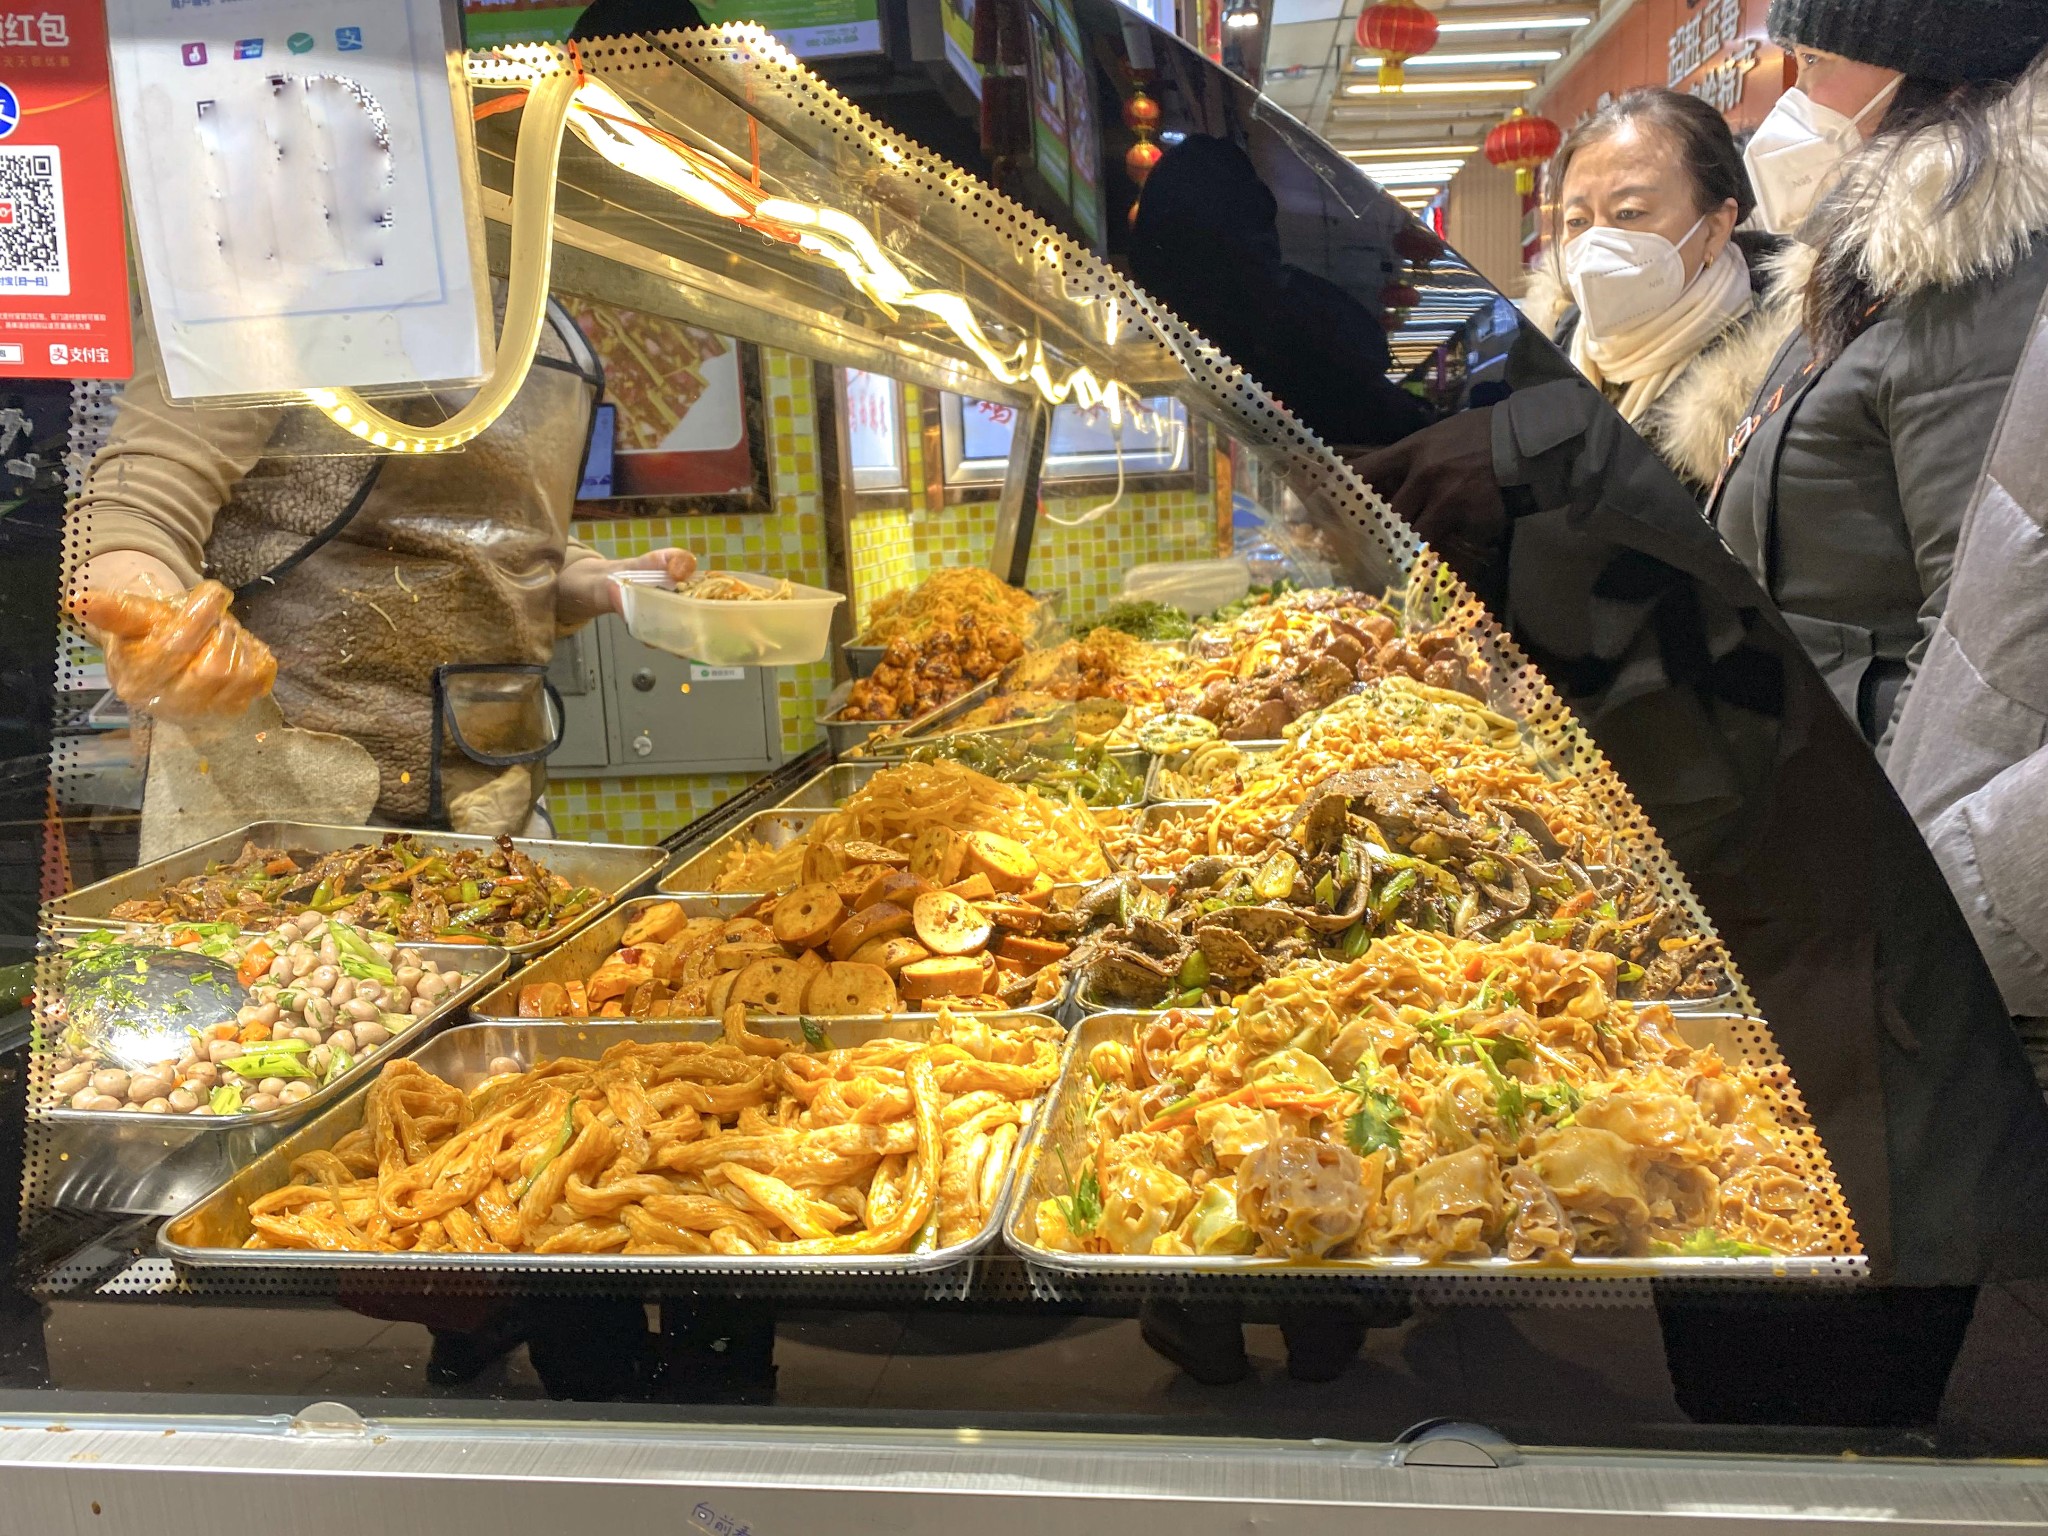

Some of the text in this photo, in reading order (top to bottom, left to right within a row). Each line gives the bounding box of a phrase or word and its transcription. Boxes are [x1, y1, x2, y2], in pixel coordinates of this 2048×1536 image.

[0, 12, 69, 47] 红包
[69, 346, 109, 363] 支付宝
